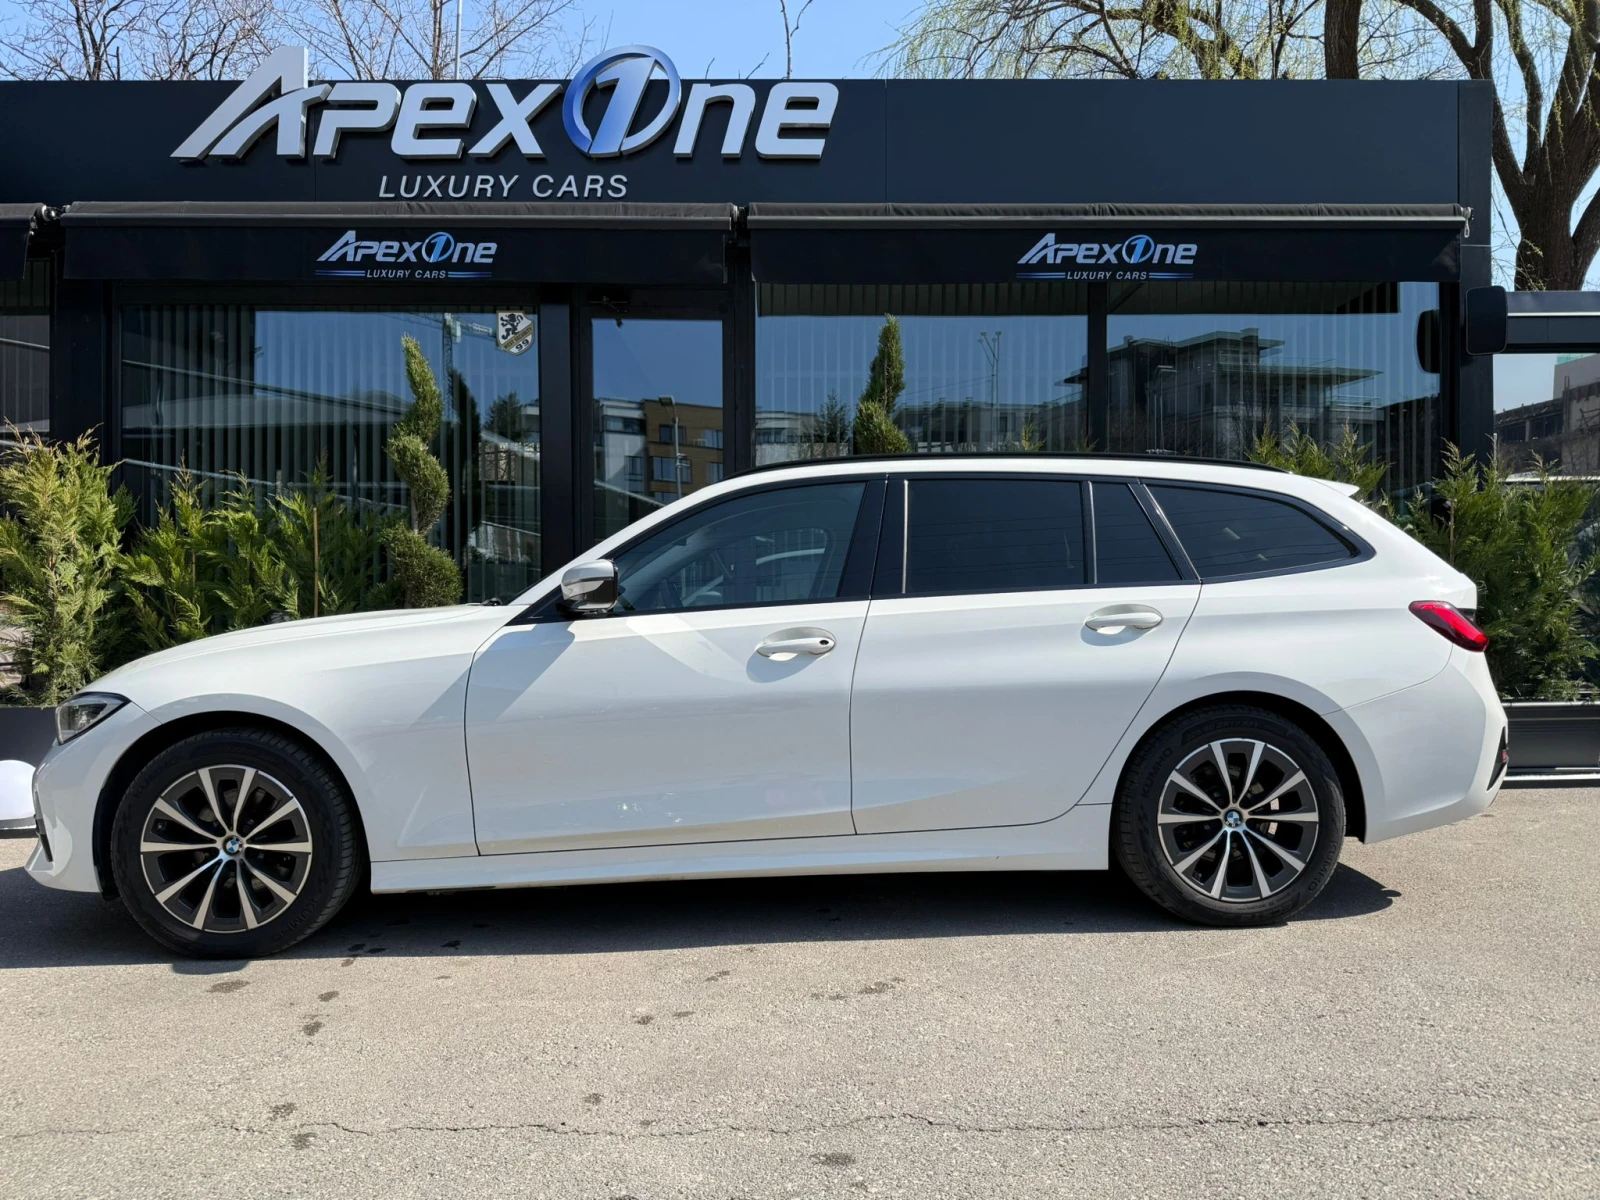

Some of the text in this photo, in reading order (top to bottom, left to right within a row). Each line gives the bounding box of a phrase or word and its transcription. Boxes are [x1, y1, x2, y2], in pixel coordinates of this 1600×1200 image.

[378, 174, 628, 198] LUXURY CARS
[366, 269, 447, 279] LUXURY CARS
[1066, 271, 1147, 280] LUXURY CARS
[515, 339, 529, 351] 99
[1139, 746, 1174, 798] KUMHO
